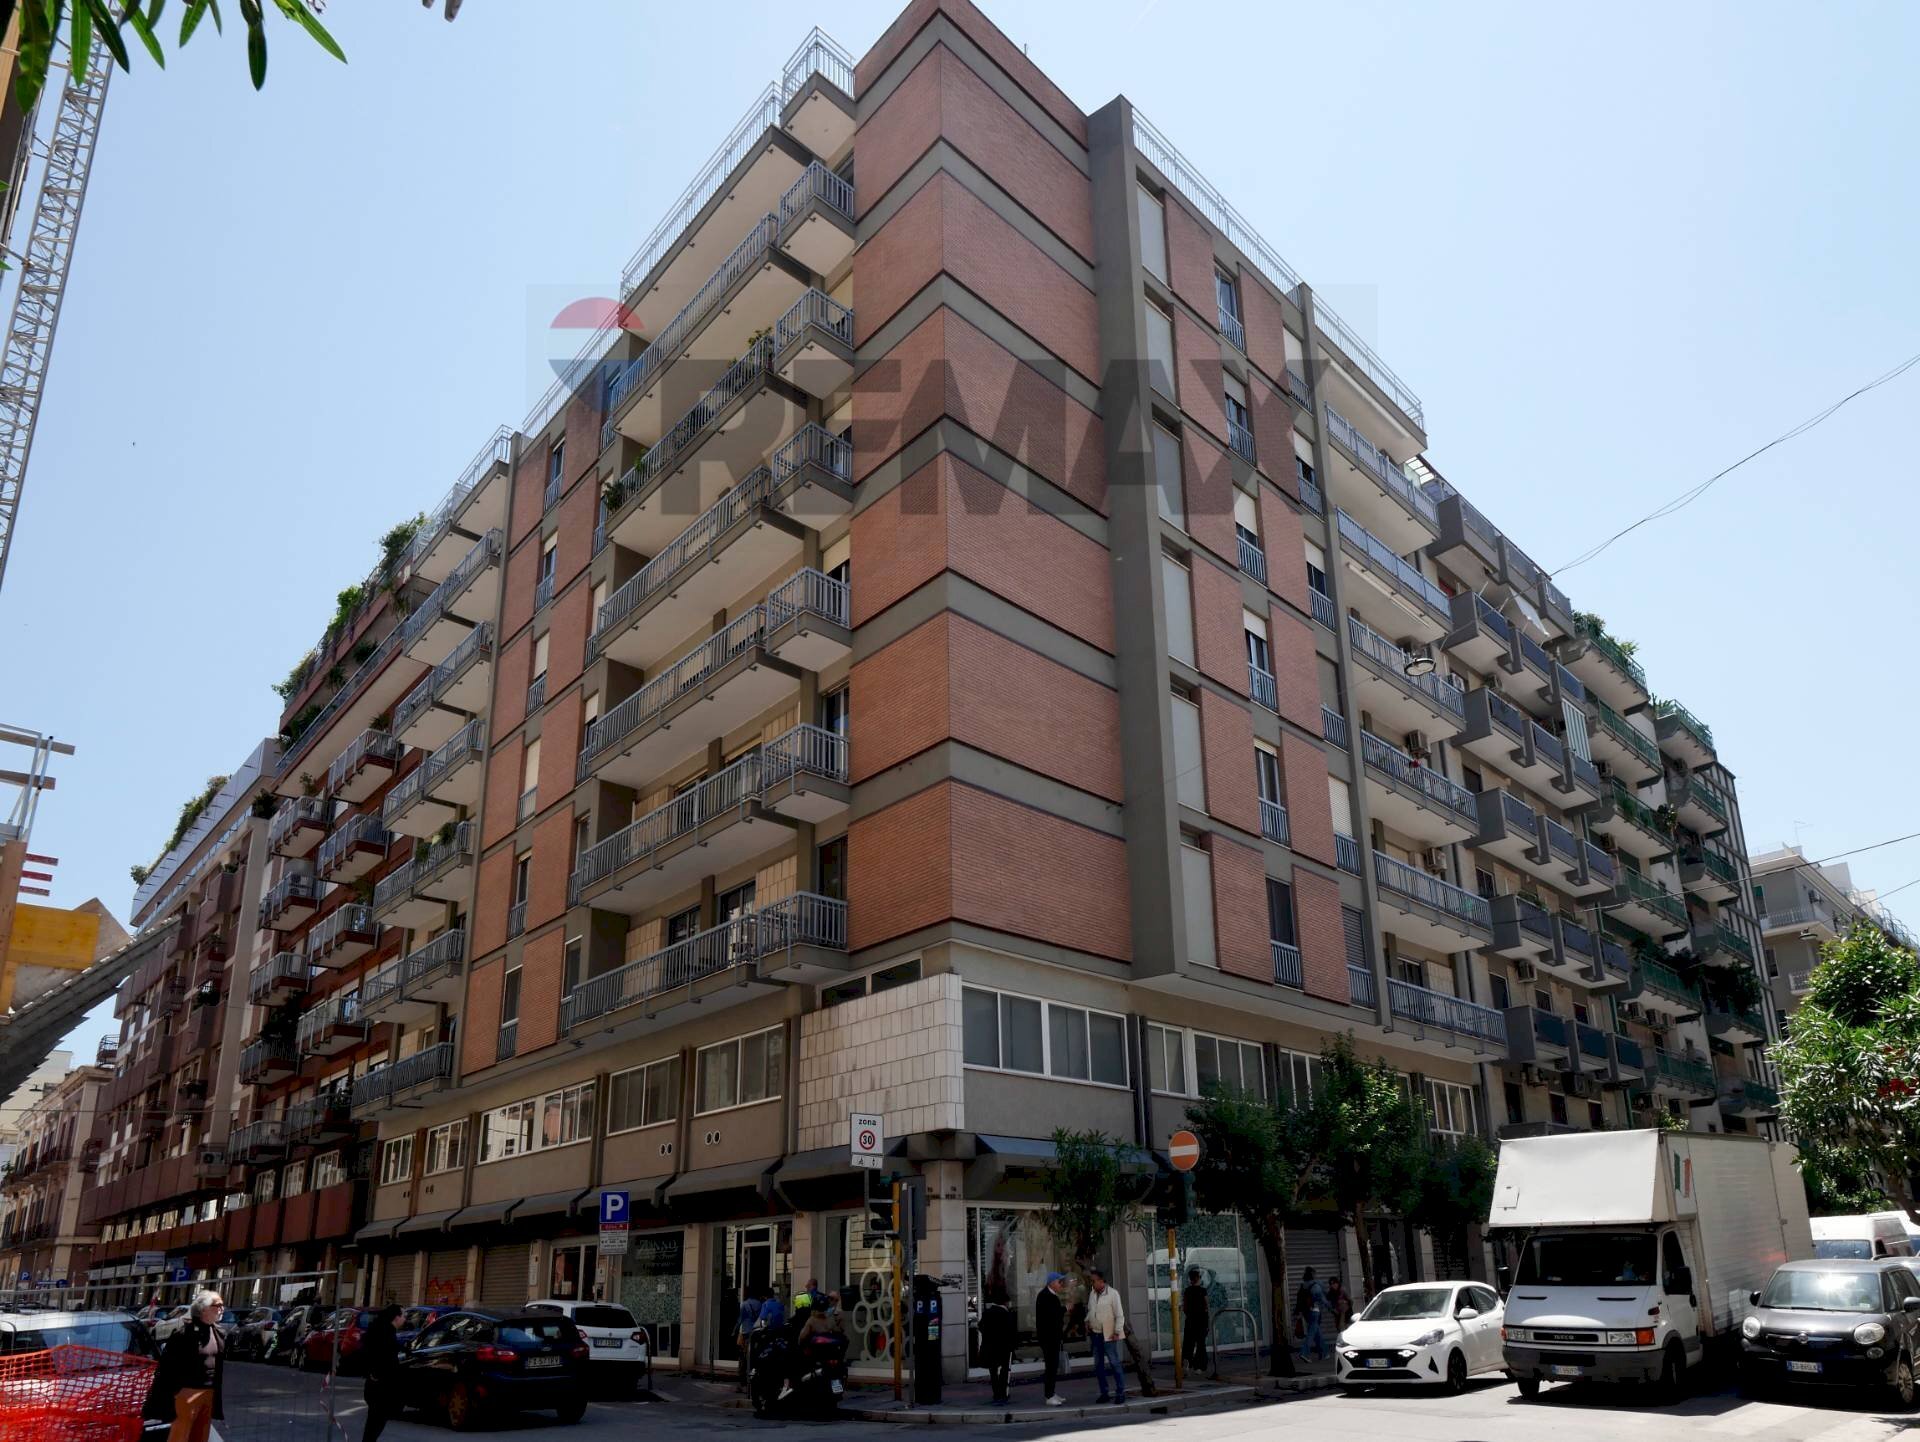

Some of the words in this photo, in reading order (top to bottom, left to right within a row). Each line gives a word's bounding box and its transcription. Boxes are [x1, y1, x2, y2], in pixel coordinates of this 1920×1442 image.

[862, 1135, 873, 1145] 30
[606, 1194, 624, 1220] P
[176, 1269, 188, 1282] P
[930, 1300, 937, 1312] P
